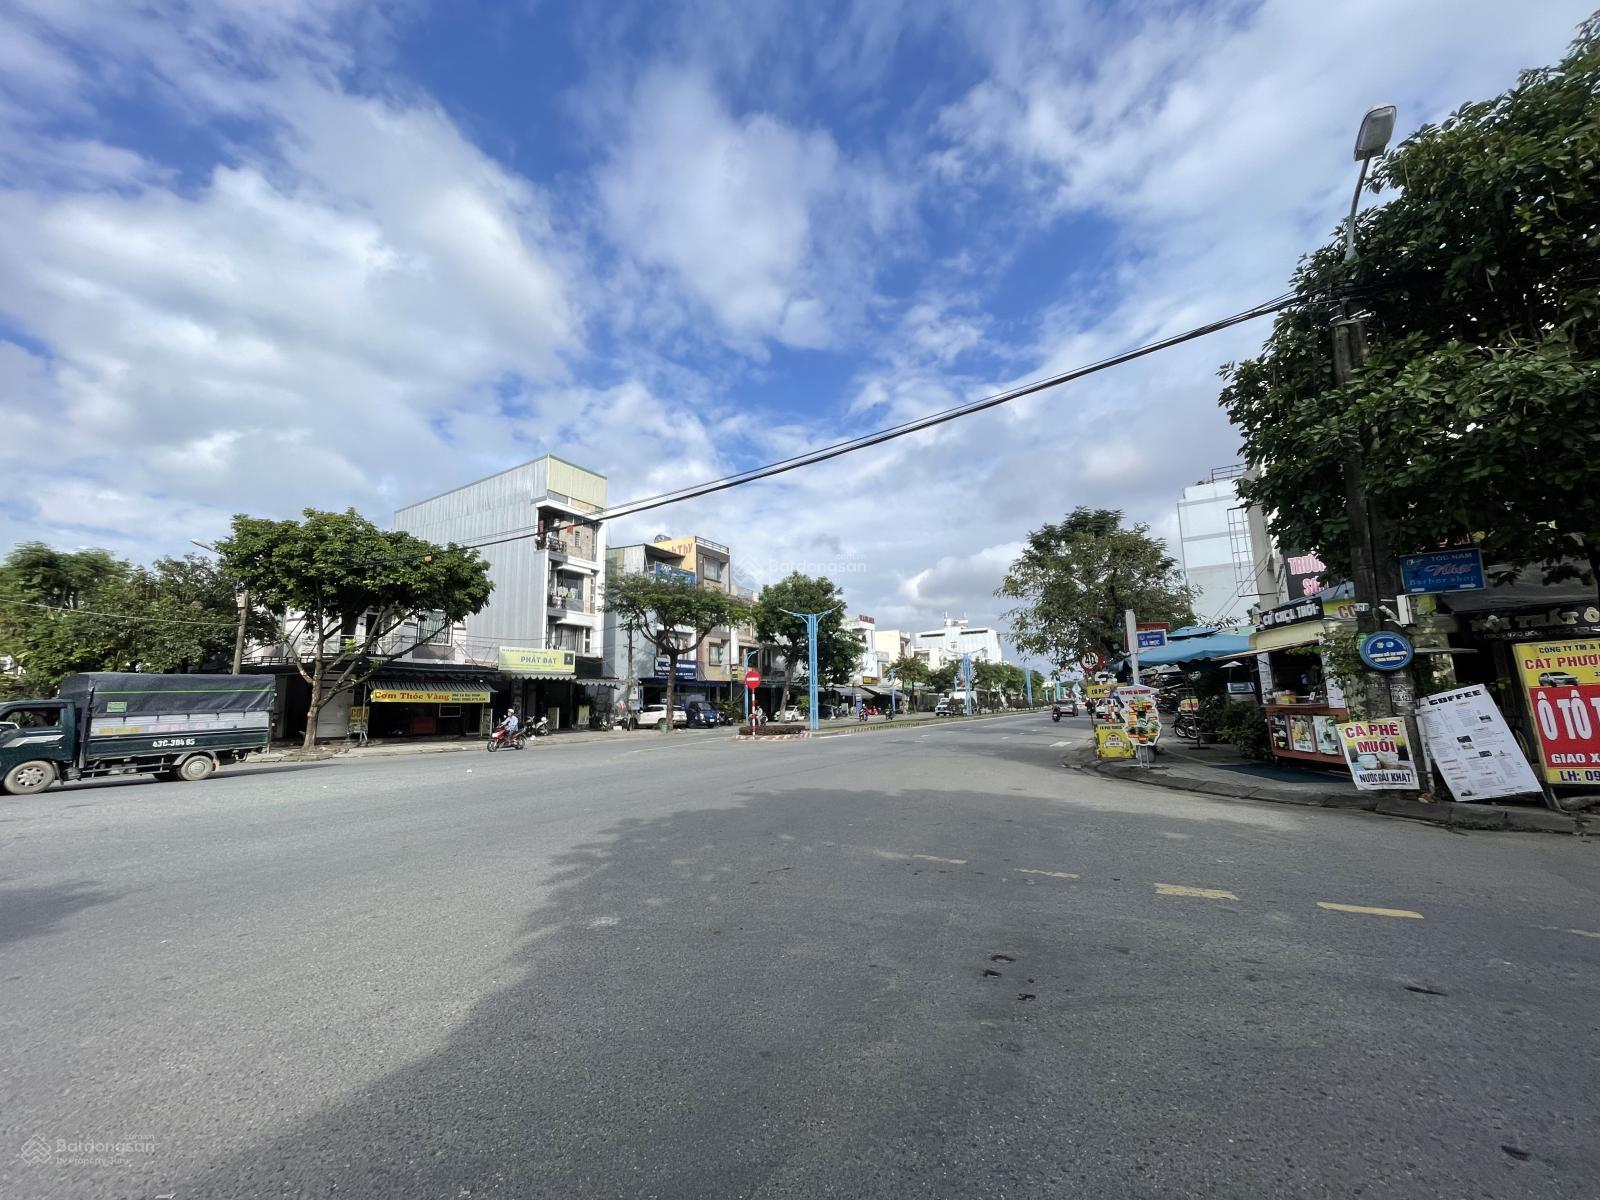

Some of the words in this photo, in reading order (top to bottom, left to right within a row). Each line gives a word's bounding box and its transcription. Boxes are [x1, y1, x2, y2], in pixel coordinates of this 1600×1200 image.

[1557, 653, 1600, 669] PHƯỢ
[1429, 690, 1482, 705] COFFEE
[1537, 691, 1558, 740] Ô
[1557, 689, 1592, 740] TÔ
[1345, 723, 1367, 738] CÀ
[1368, 722, 1400, 736] PHÊ
[1357, 736, 1396, 752] MUỐI
[1551, 753, 1586, 764] GIAO
[1391, 770, 1411, 783] KHÁT
[1560, 770, 1582, 781] LH:
